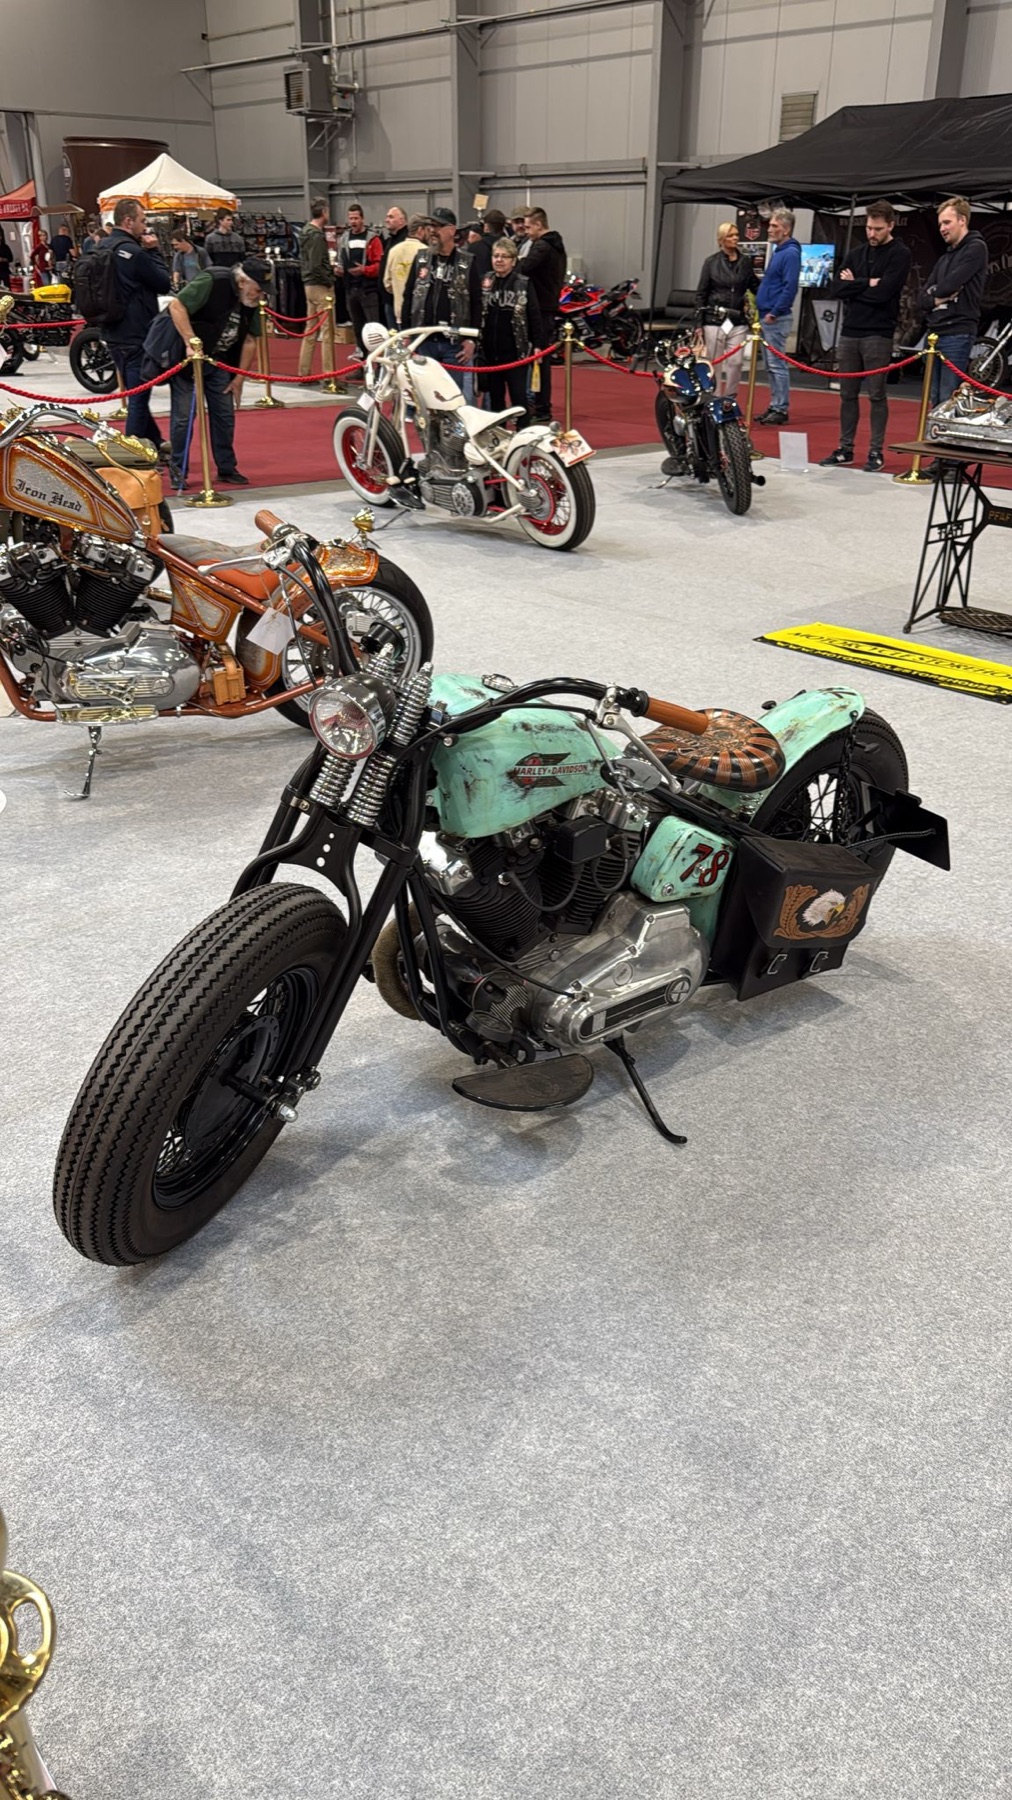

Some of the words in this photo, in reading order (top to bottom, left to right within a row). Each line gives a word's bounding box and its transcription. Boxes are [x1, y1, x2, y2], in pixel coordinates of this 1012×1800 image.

[14, 479, 47, 501] Iron
[48, 491, 82, 512] Head
[679, 843, 730, 887] 78
